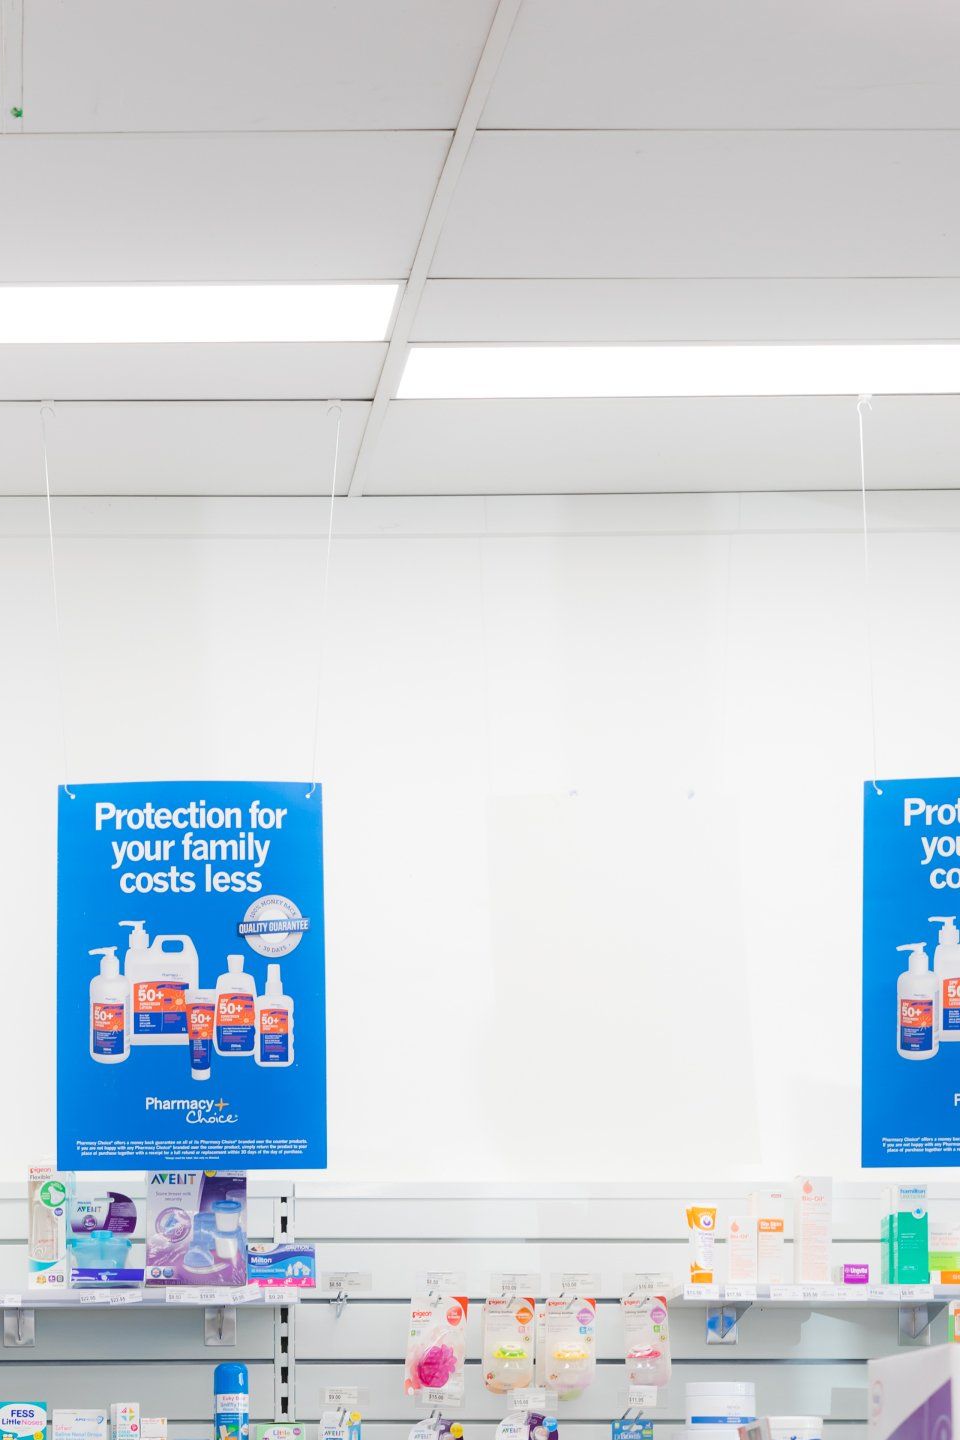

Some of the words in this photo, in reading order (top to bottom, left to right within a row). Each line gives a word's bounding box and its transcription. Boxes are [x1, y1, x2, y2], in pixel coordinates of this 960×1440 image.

[95, 800, 242, 831] Protection
[249, 800, 287, 829] for
[111, 840, 175, 869] your
[182, 832, 271, 867] family
[120, 866, 196, 893] costs
[205, 864, 262, 893] less
[261, 899, 283, 908] MONEY
[283, 902, 296, 916] BACK
[239, 922, 268, 934] QUALITY
[268, 919, 309, 932] GUARANTEE
[138, 989, 164, 1002] 50+
[219, 1002, 243, 1013] 50+
[901, 1006, 922, 1017] 50+
[94, 1010, 114, 1021] 50+
[191, 1013, 212, 1024] 50+
[262, 1016, 279, 1025] 50+
[145, 1096, 214, 1112] Pharmacy
[186, 1110, 238, 1124] Choice
[151, 1174, 196, 1185] AVENT
[11, 1409, 35, 1417] FESS
